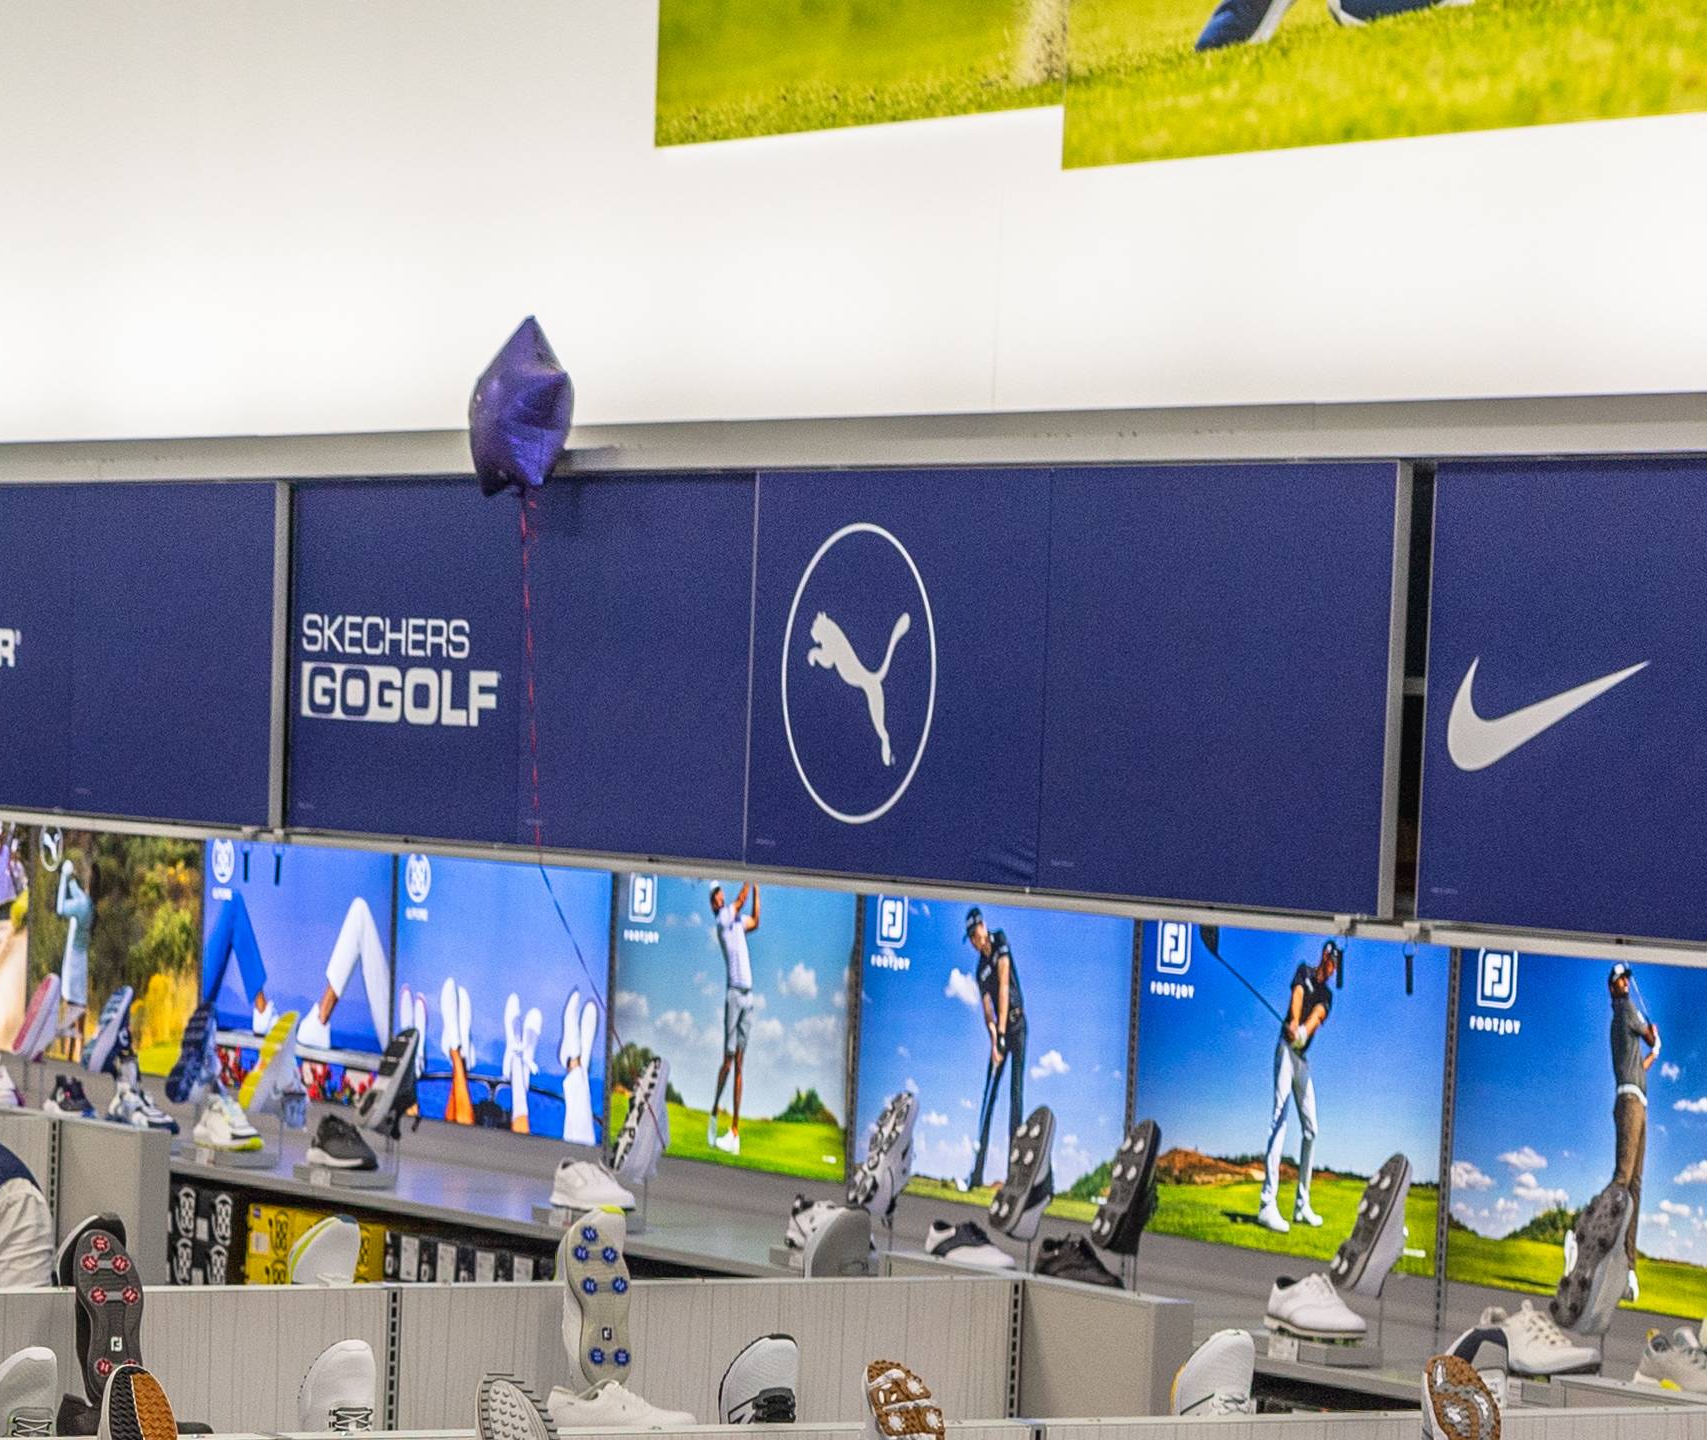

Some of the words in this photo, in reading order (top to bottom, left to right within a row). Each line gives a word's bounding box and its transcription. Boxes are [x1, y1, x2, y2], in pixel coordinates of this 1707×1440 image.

[301, 611, 470, 660] SKECHERS
[1150, 980, 1195, 999] FOOTJOY
[1470, 1014, 1521, 1036] FOOTJOY
